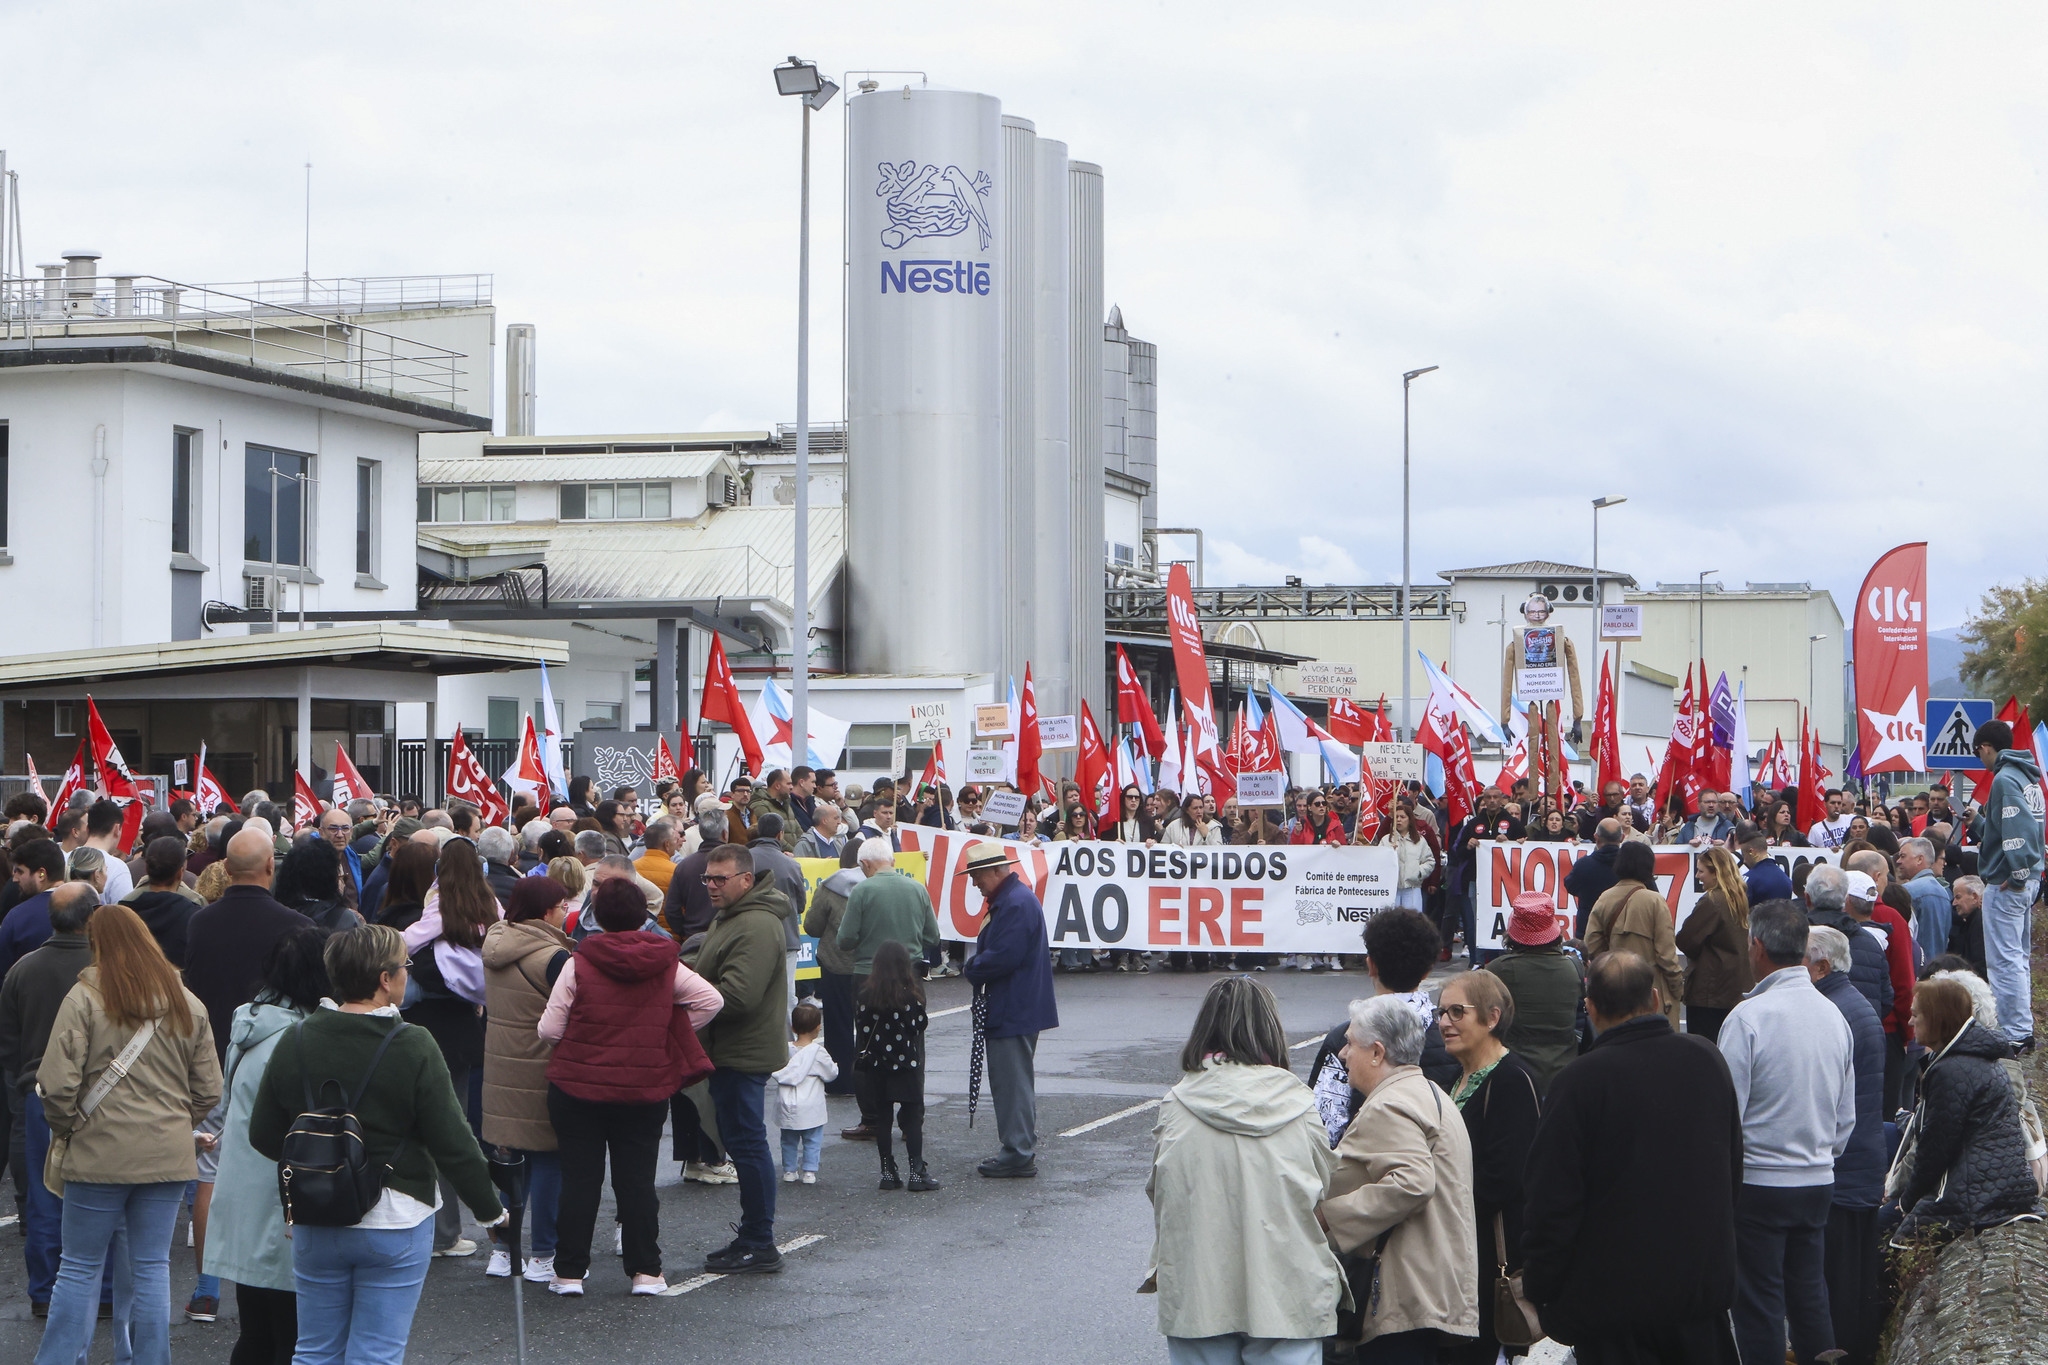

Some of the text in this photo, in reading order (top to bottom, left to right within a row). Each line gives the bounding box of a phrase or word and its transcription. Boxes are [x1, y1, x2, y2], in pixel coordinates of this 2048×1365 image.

[1868, 586, 1921, 622] CIG
[1308, 684, 1351, 695] PERDICIÓN
[925, 719, 940, 728] AO
[918, 727, 951, 741] ERE!
[1886, 721, 1923, 742] CIG
[1380, 744, 1412, 754] NESTLÉ
[1055, 847, 1288, 881] AOS DESPIDOS
[1306, 871, 1378, 884] Comité de empresa
[1295, 885, 1389, 896] Fábrica de Pontecesures
[1053, 883, 1265, 947] AO ERE
[1337, 906, 1380, 922] Nestl
[121, 1044, 138, 1064] COBS
